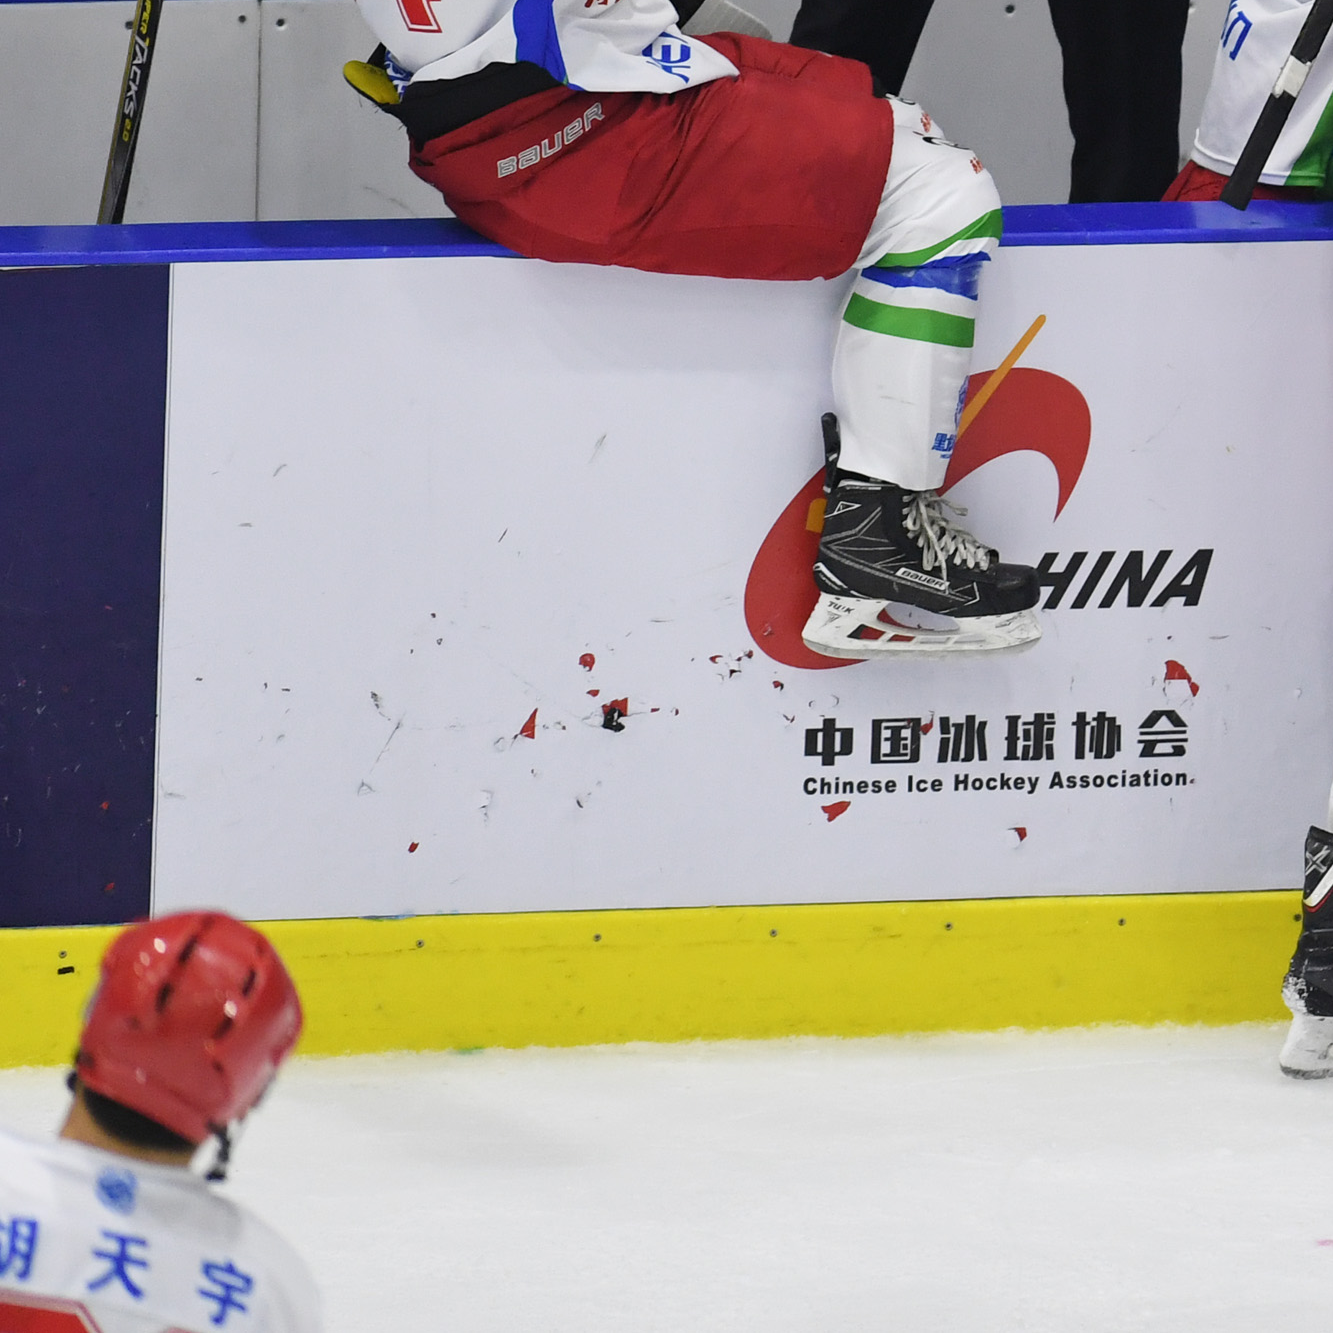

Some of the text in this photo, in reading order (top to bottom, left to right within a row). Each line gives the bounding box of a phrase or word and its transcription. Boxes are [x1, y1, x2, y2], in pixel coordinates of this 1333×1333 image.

[122, 36, 152, 117] TACKS
[804, 709, 1190, 767] 中国冰球协会
[803, 777, 897, 795] Chinese
[907, 775, 943, 793] Ice
[954, 773, 1039, 794] Hockey
